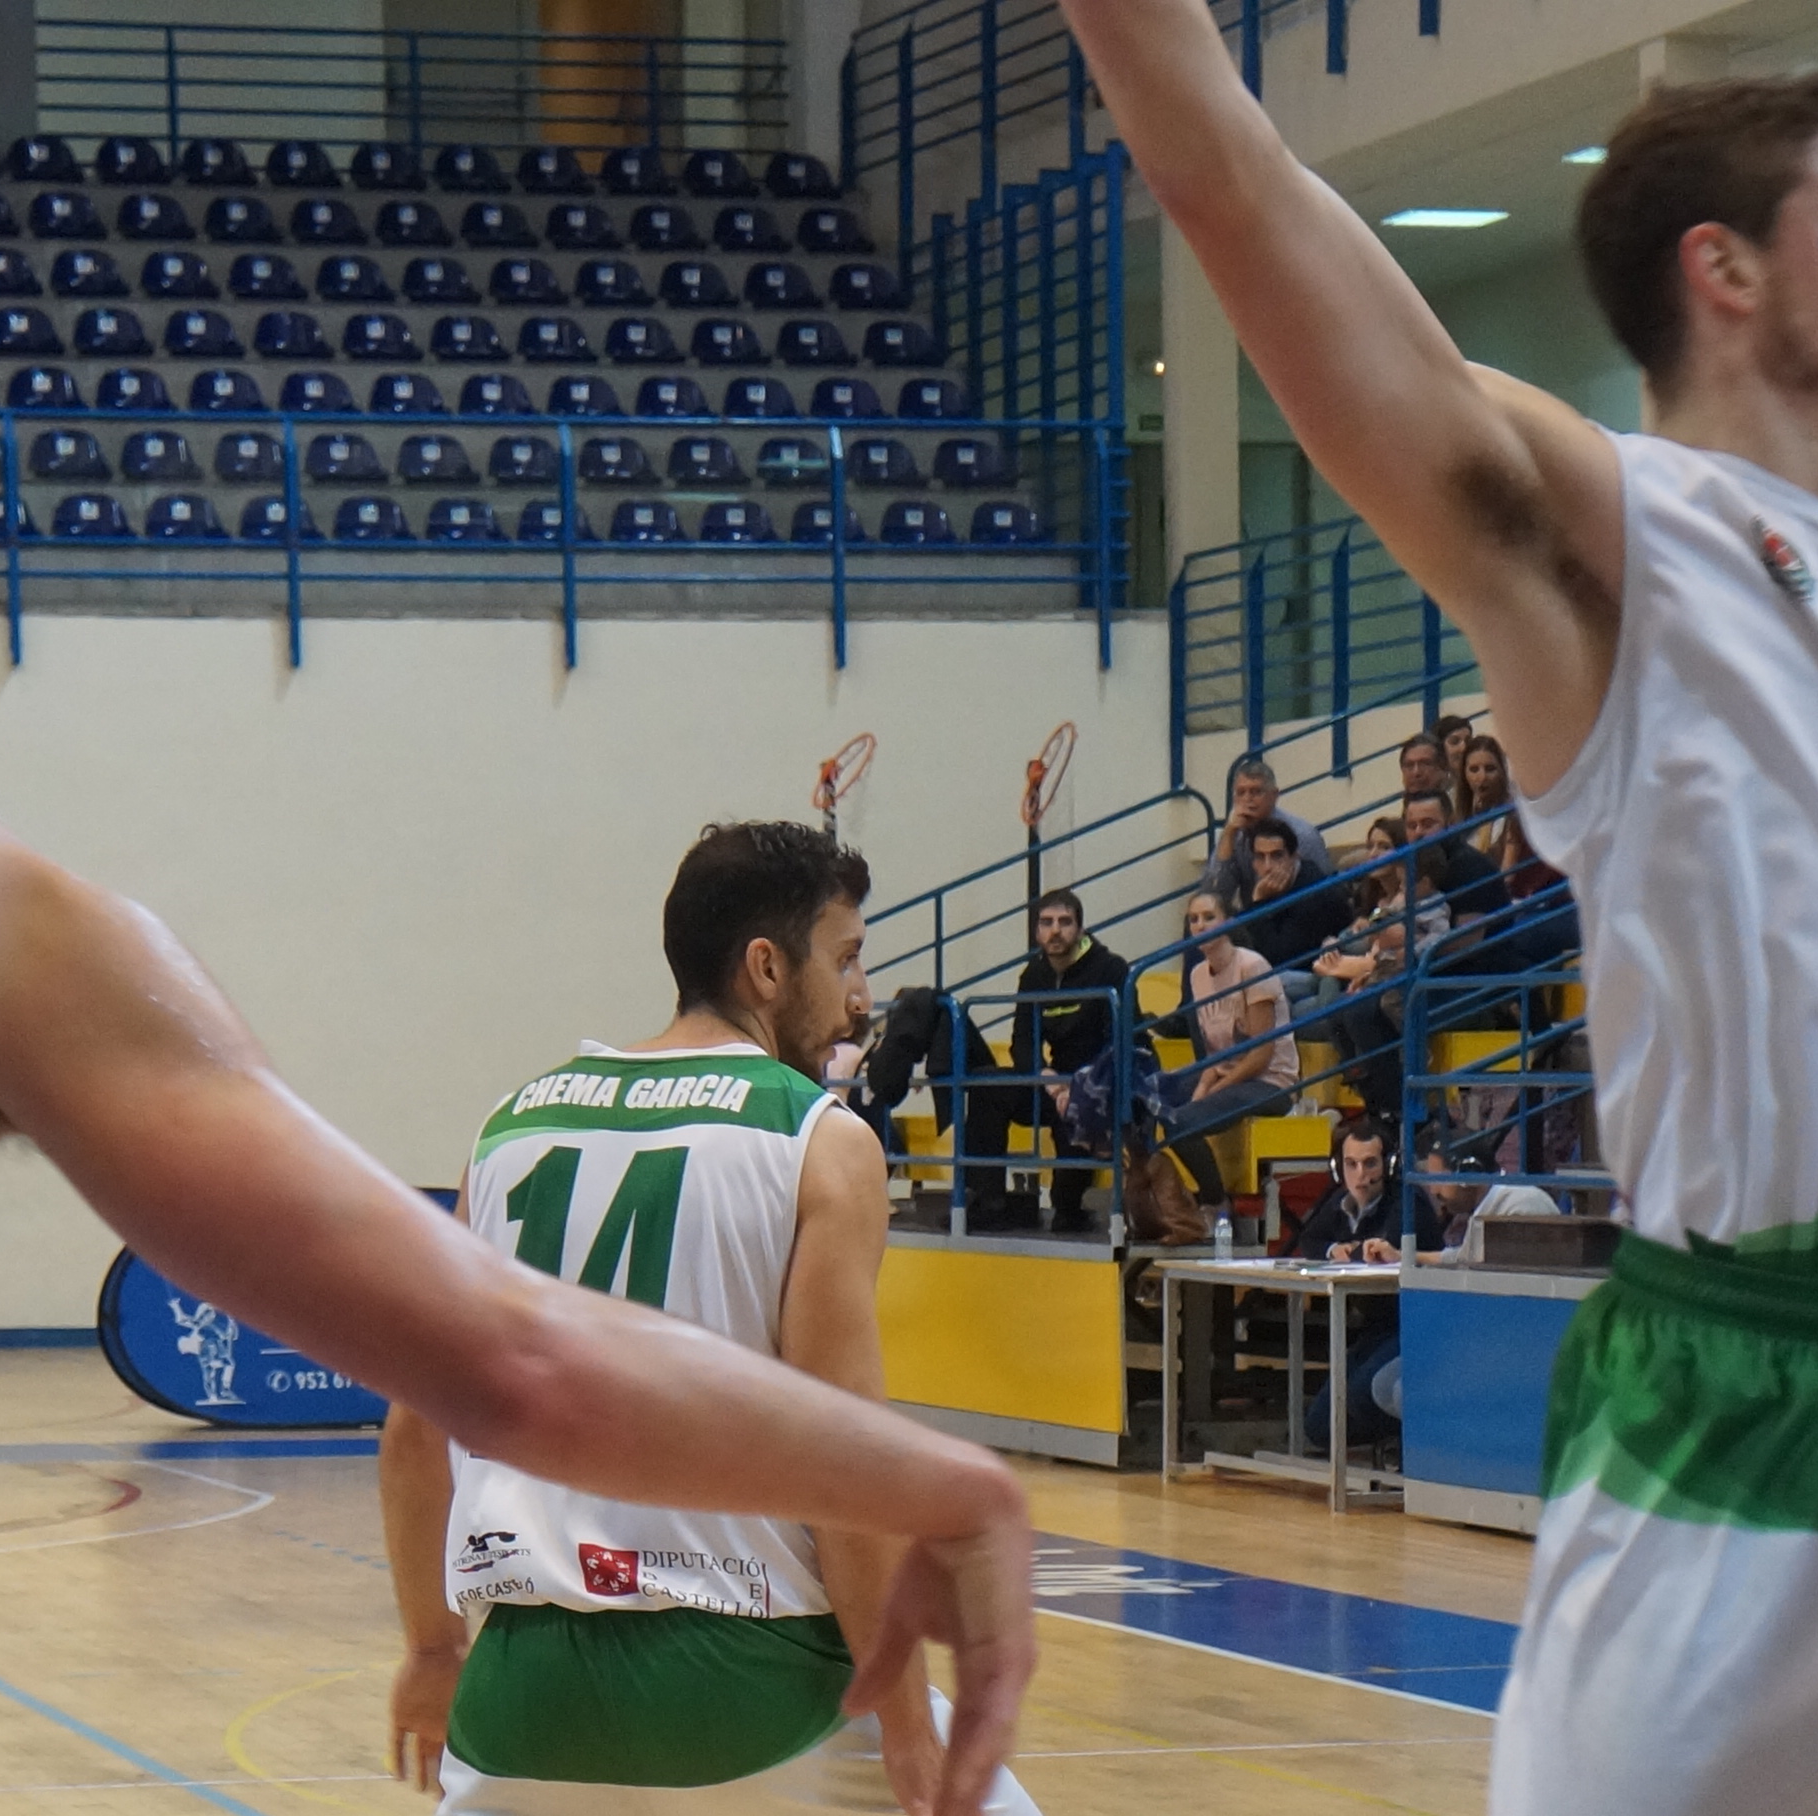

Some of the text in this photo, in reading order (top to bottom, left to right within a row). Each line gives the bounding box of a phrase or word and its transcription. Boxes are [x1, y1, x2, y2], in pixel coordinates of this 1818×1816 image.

[512, 1073, 753, 1116] CHEMA GARCIA
[506, 1145, 691, 1313] 14
[294, 1371, 329, 1390] 952
[642, 1550, 761, 1578] DIPUTACIÓ
[485, 1577, 535, 1598] CASTEÓ
